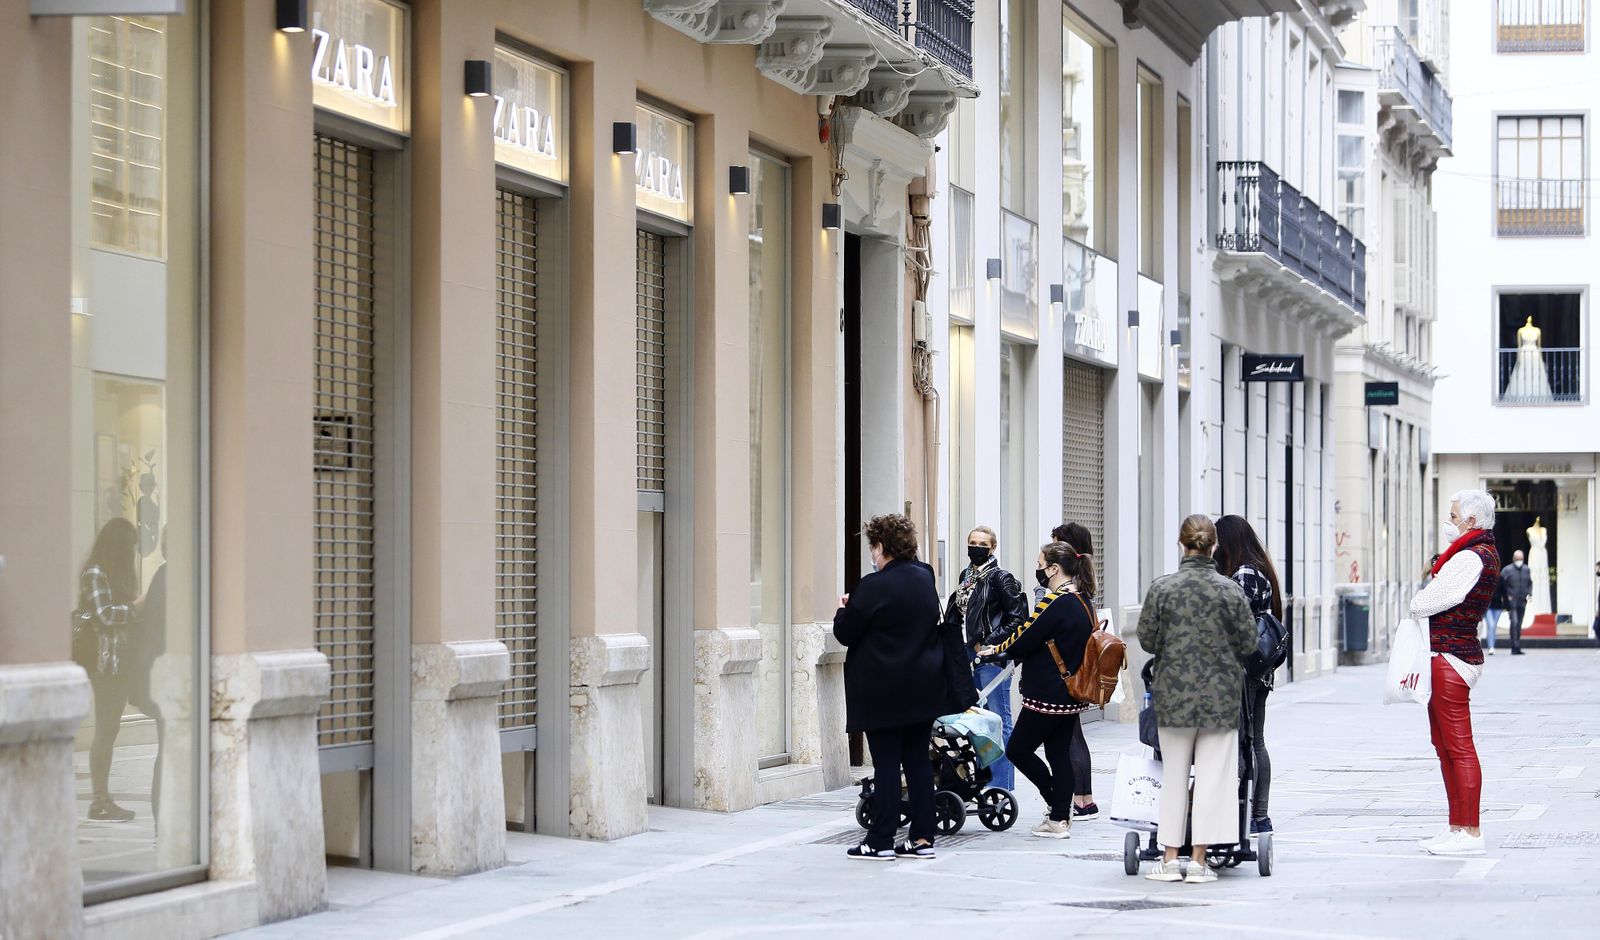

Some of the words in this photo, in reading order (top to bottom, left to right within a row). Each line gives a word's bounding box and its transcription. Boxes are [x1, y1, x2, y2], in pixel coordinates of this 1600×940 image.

[312, 29, 398, 107] ZARA
[494, 95, 558, 160] ZARA
[1250, 362, 1295, 376] Subdued
